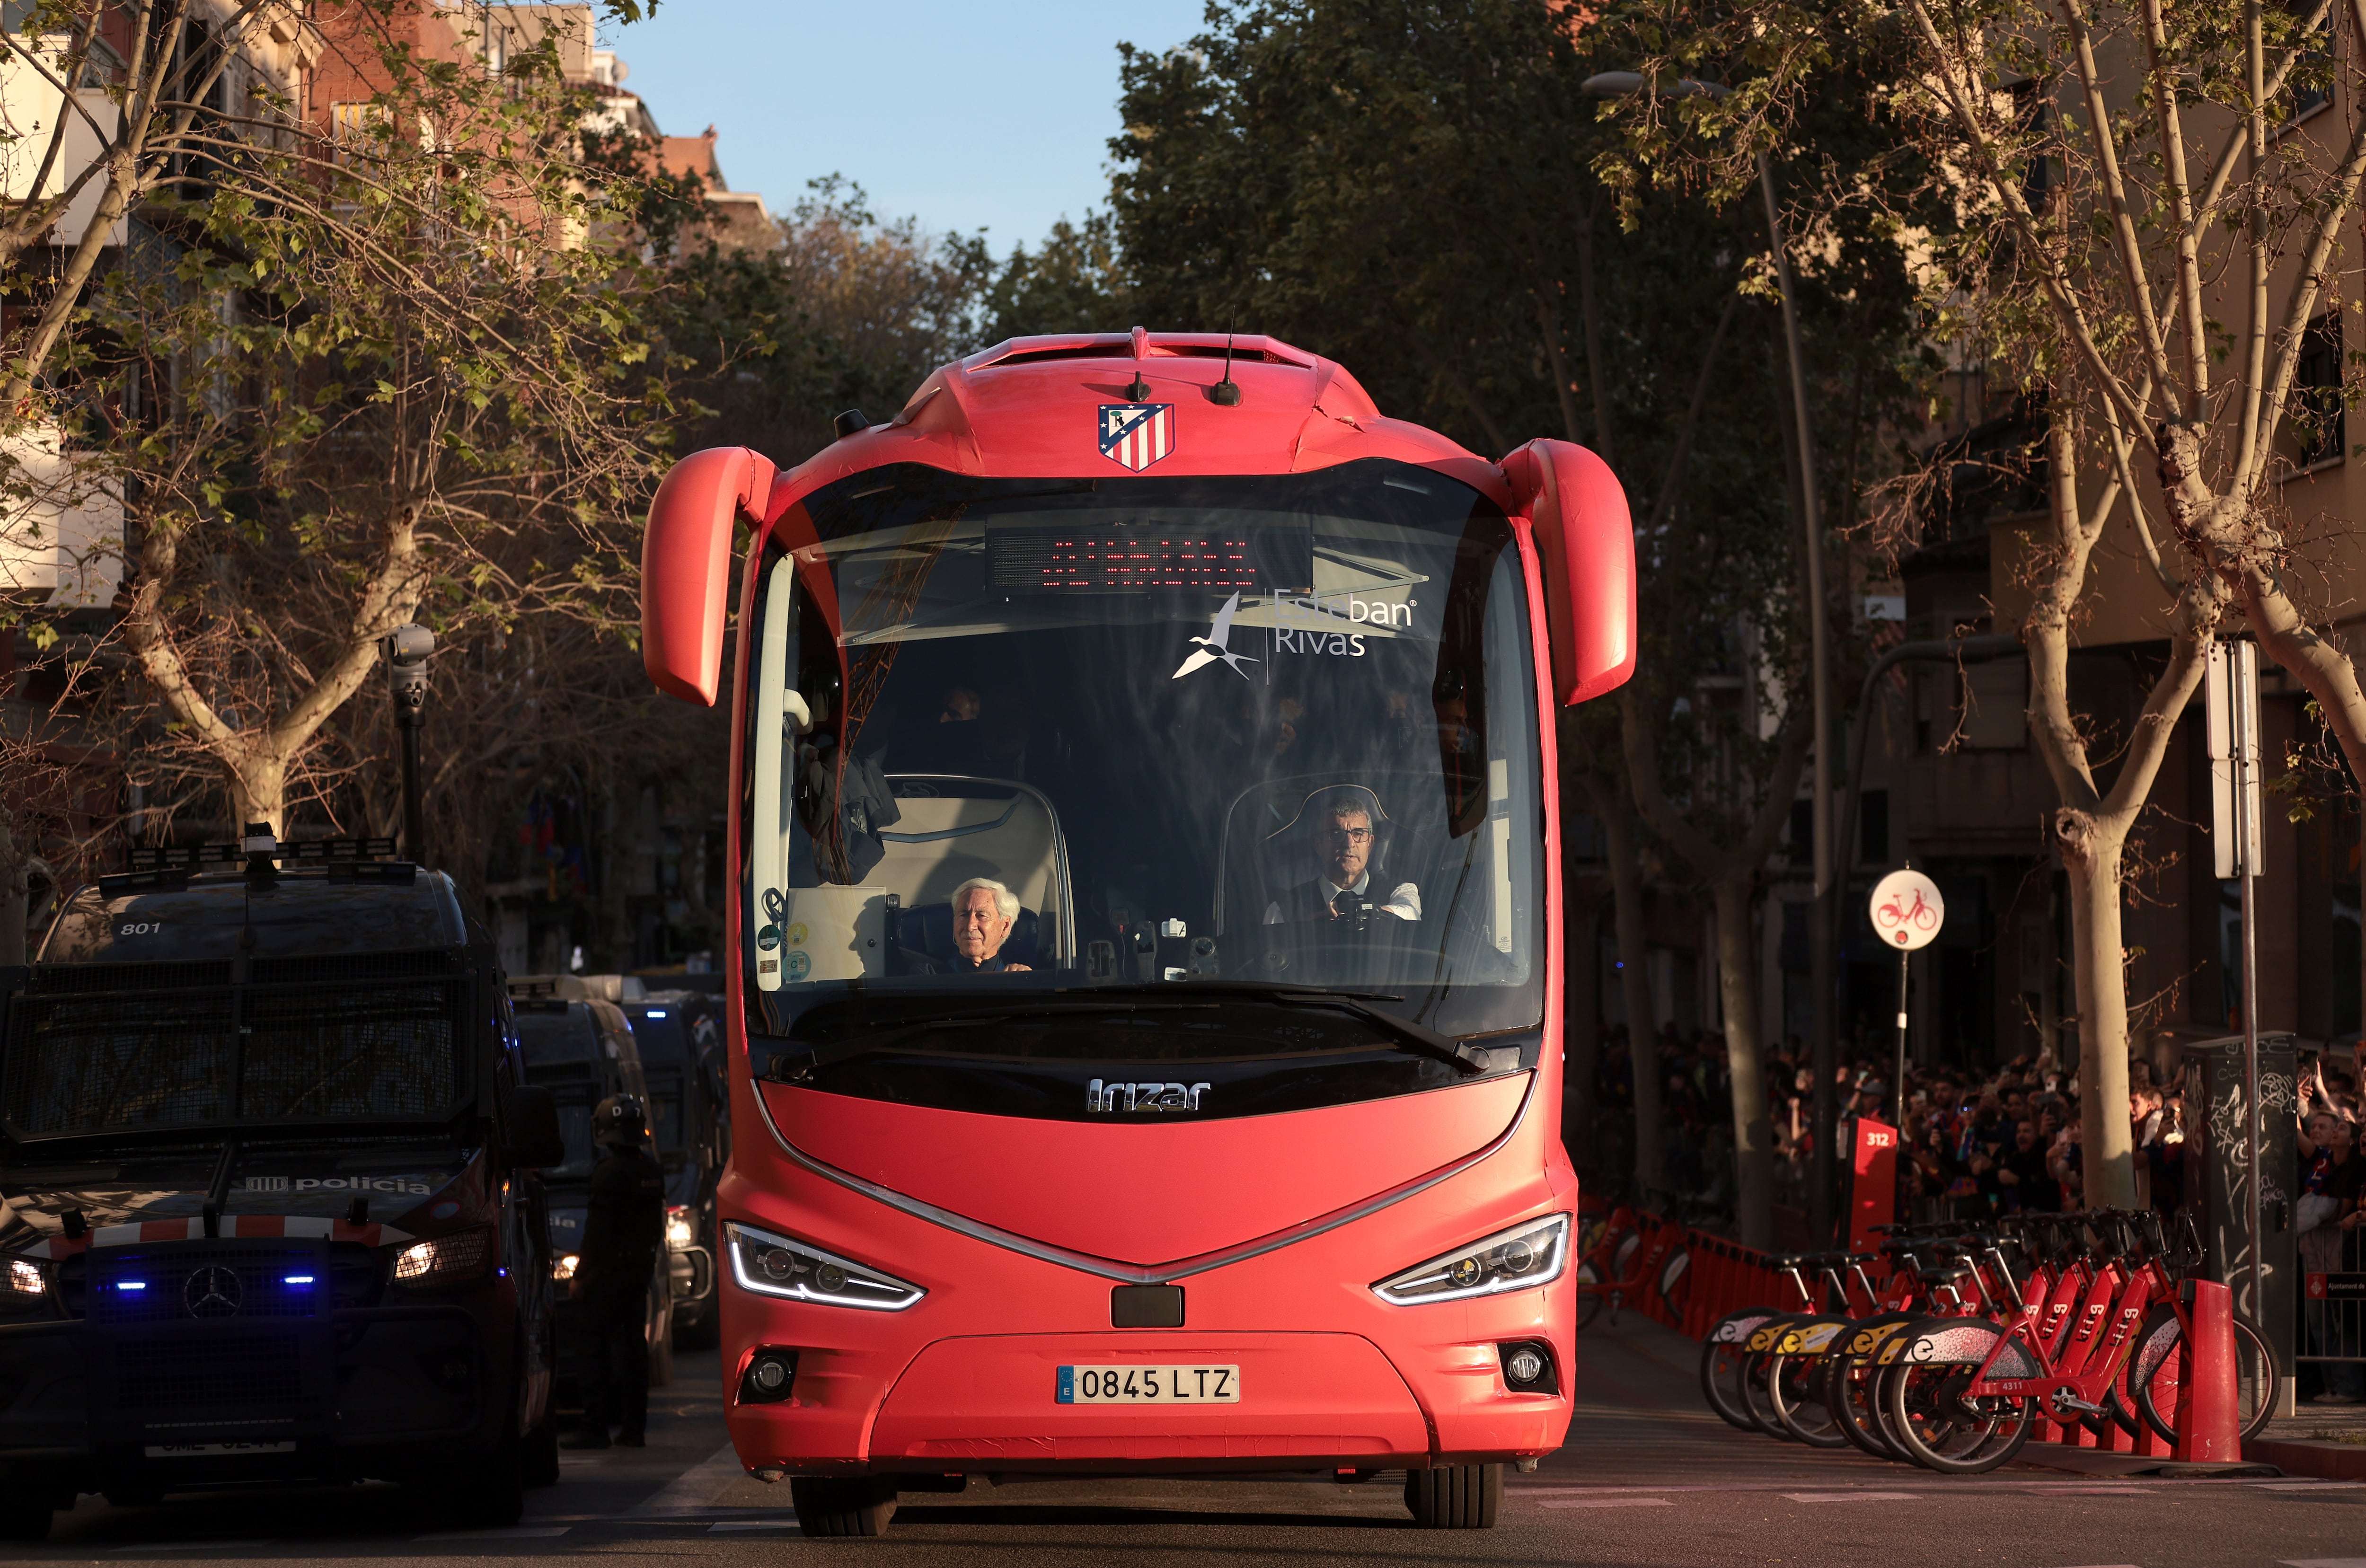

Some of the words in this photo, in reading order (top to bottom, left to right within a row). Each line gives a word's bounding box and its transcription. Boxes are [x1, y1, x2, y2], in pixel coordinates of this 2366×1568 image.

[1275, 629, 1365, 656] Rivas
[121, 922, 161, 935] 801
[1087, 1078, 1211, 1112] Irizar
[1866, 1132, 1889, 1146] 312
[296, 1176, 431, 1196] policia
[2328, 1282, 2357, 1291] Ajuntament
[2039, 1303, 2068, 1340] bicing
[2075, 1304, 2105, 1343] bicing
[2109, 1307, 2139, 1347] bicing
[1063, 1387, 1070, 1396] E
[1082, 1370, 1159, 1398] 0845
[1174, 1369, 1231, 1398] LTZ
[2002, 1381, 2023, 1391] 4311
